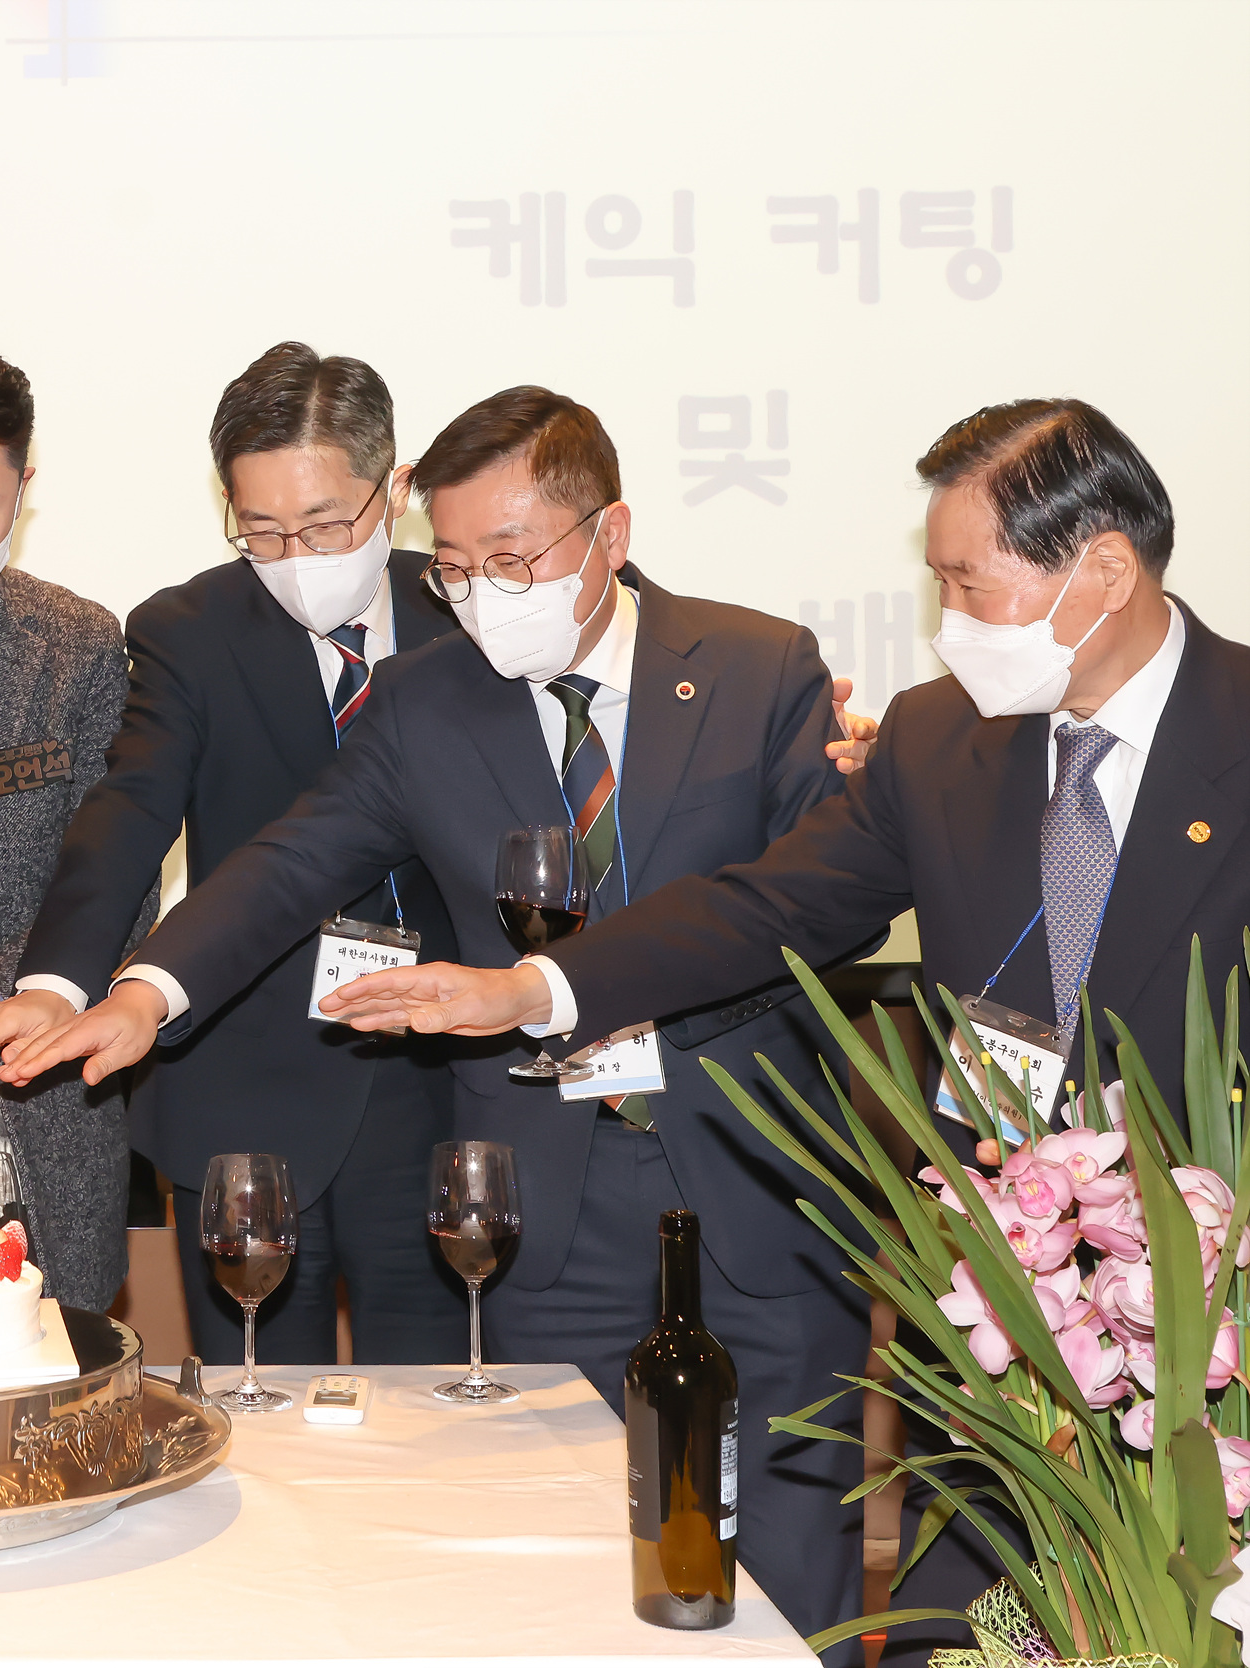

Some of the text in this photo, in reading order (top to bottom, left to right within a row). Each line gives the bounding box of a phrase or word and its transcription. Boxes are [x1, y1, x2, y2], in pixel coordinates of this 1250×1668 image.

[448, 185, 1016, 308] 케익 커팅
[676, 389, 790, 507] 및
[338, 947, 399, 967] 대한의사협회
[327, 966, 340, 982] 이
[632, 1030, 648, 1048] 하
[958, 1054, 973, 1073] 이
